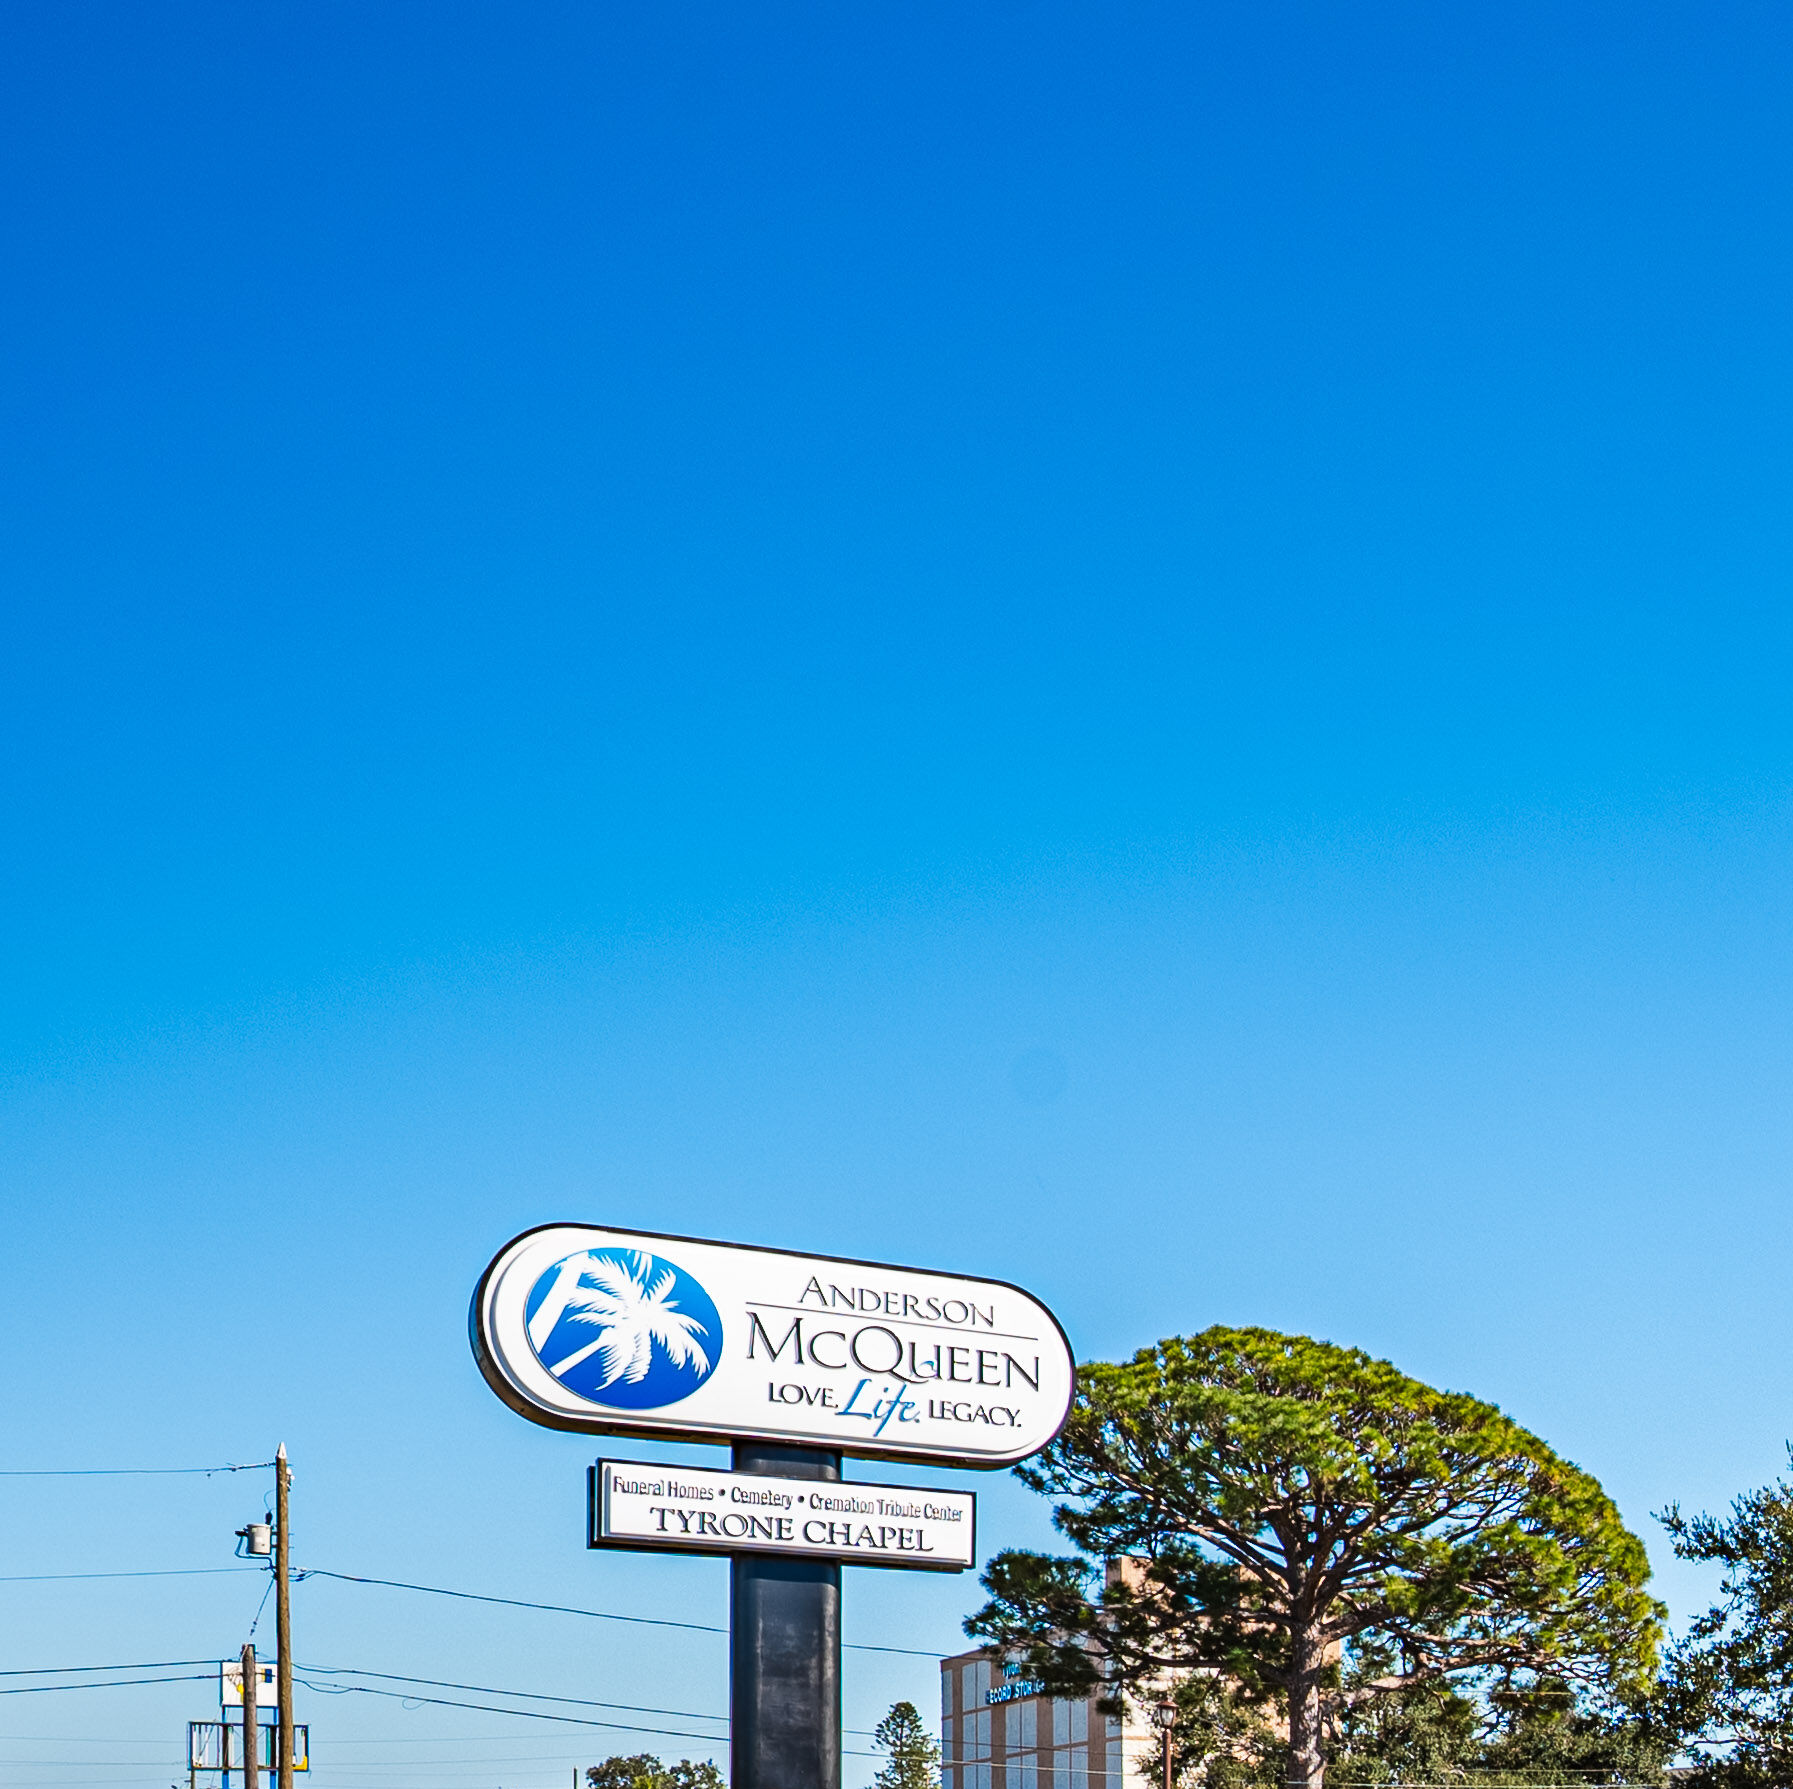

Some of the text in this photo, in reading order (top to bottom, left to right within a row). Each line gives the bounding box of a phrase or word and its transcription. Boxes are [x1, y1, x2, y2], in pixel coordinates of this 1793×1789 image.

[798, 1276, 994, 1328] ANDERSON
[928, 1399, 1022, 1428] LEGACY.
[612, 1475, 963, 1522] Funeral Homes Cemetery Cremation Tribute Center
[650, 1507, 934, 1552] TYRONE CHAPEL
